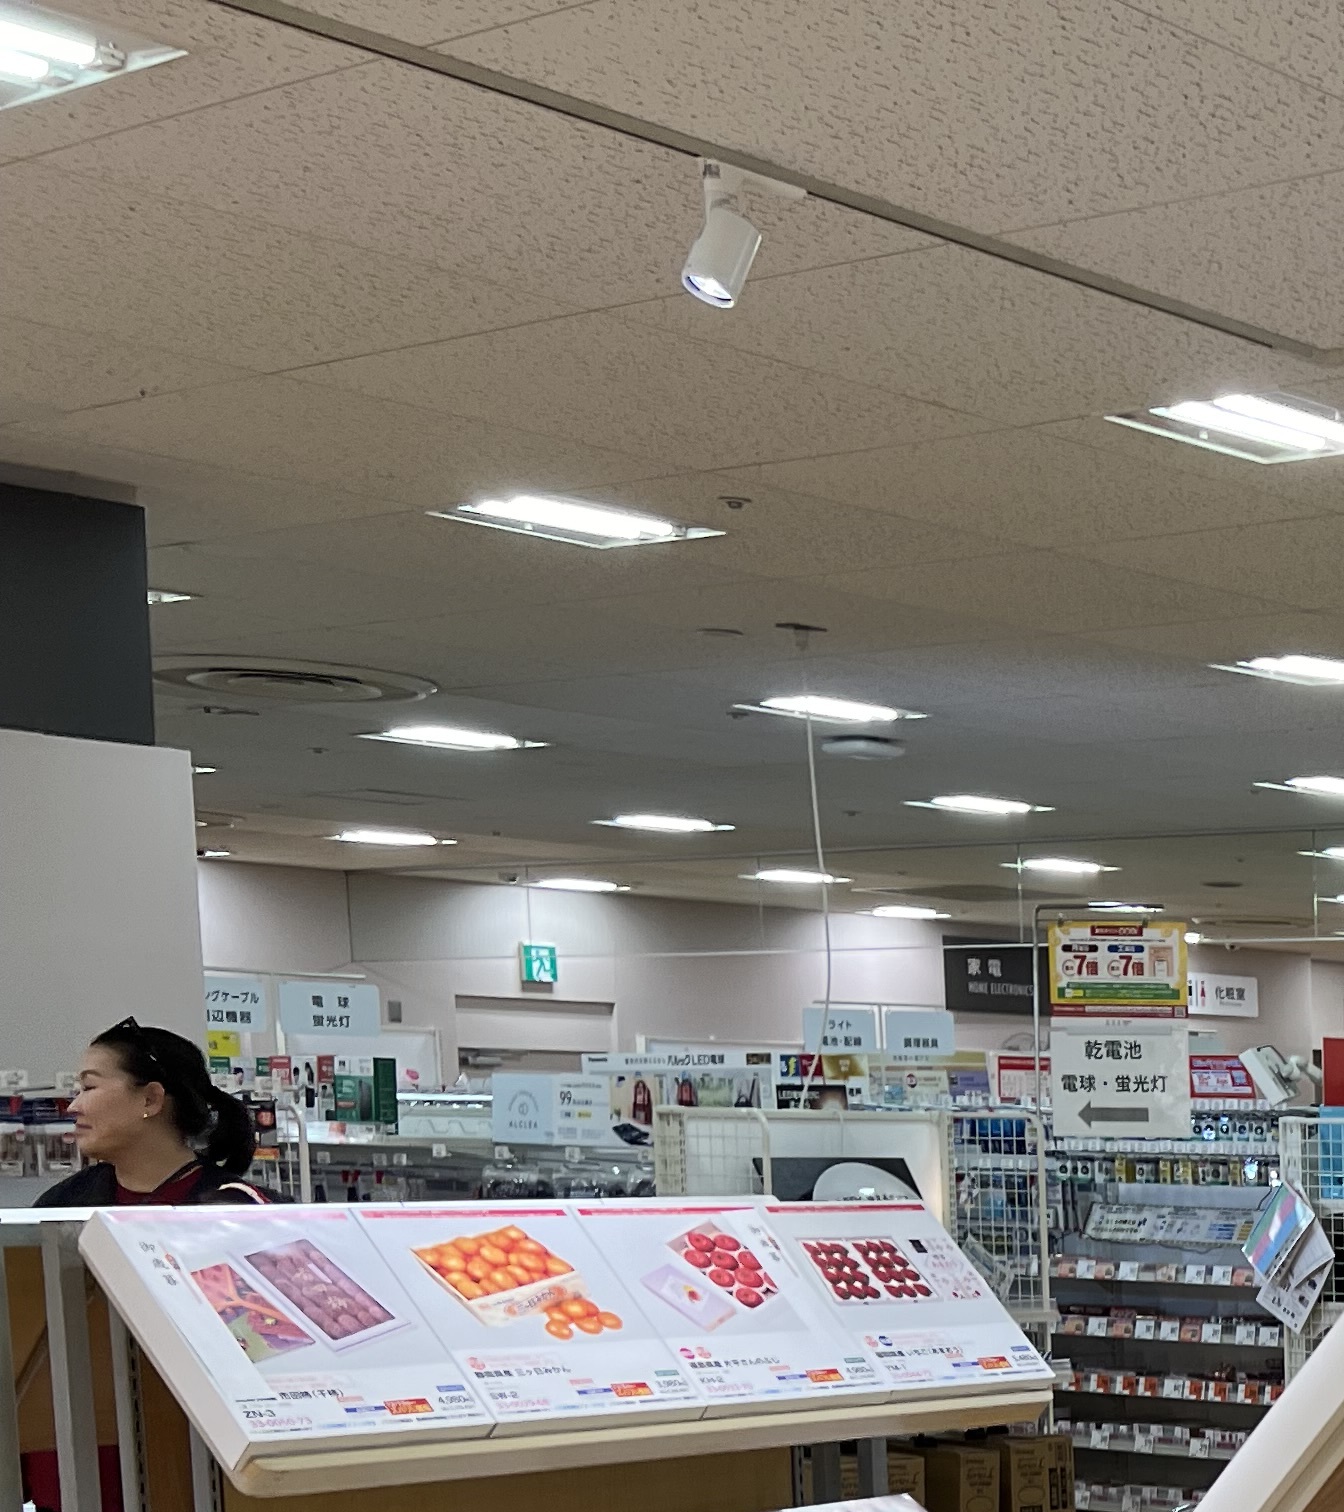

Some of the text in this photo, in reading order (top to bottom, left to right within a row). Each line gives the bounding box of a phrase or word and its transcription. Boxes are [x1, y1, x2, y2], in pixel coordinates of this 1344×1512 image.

[206, 1009, 252, 1024] 辺機器
[312, 1015, 350, 1028] 蛍光灯
[1084, 1040, 1142, 1060] 乾電池
[1061, 1074, 1168, 1093] 電球・蛍光灯
